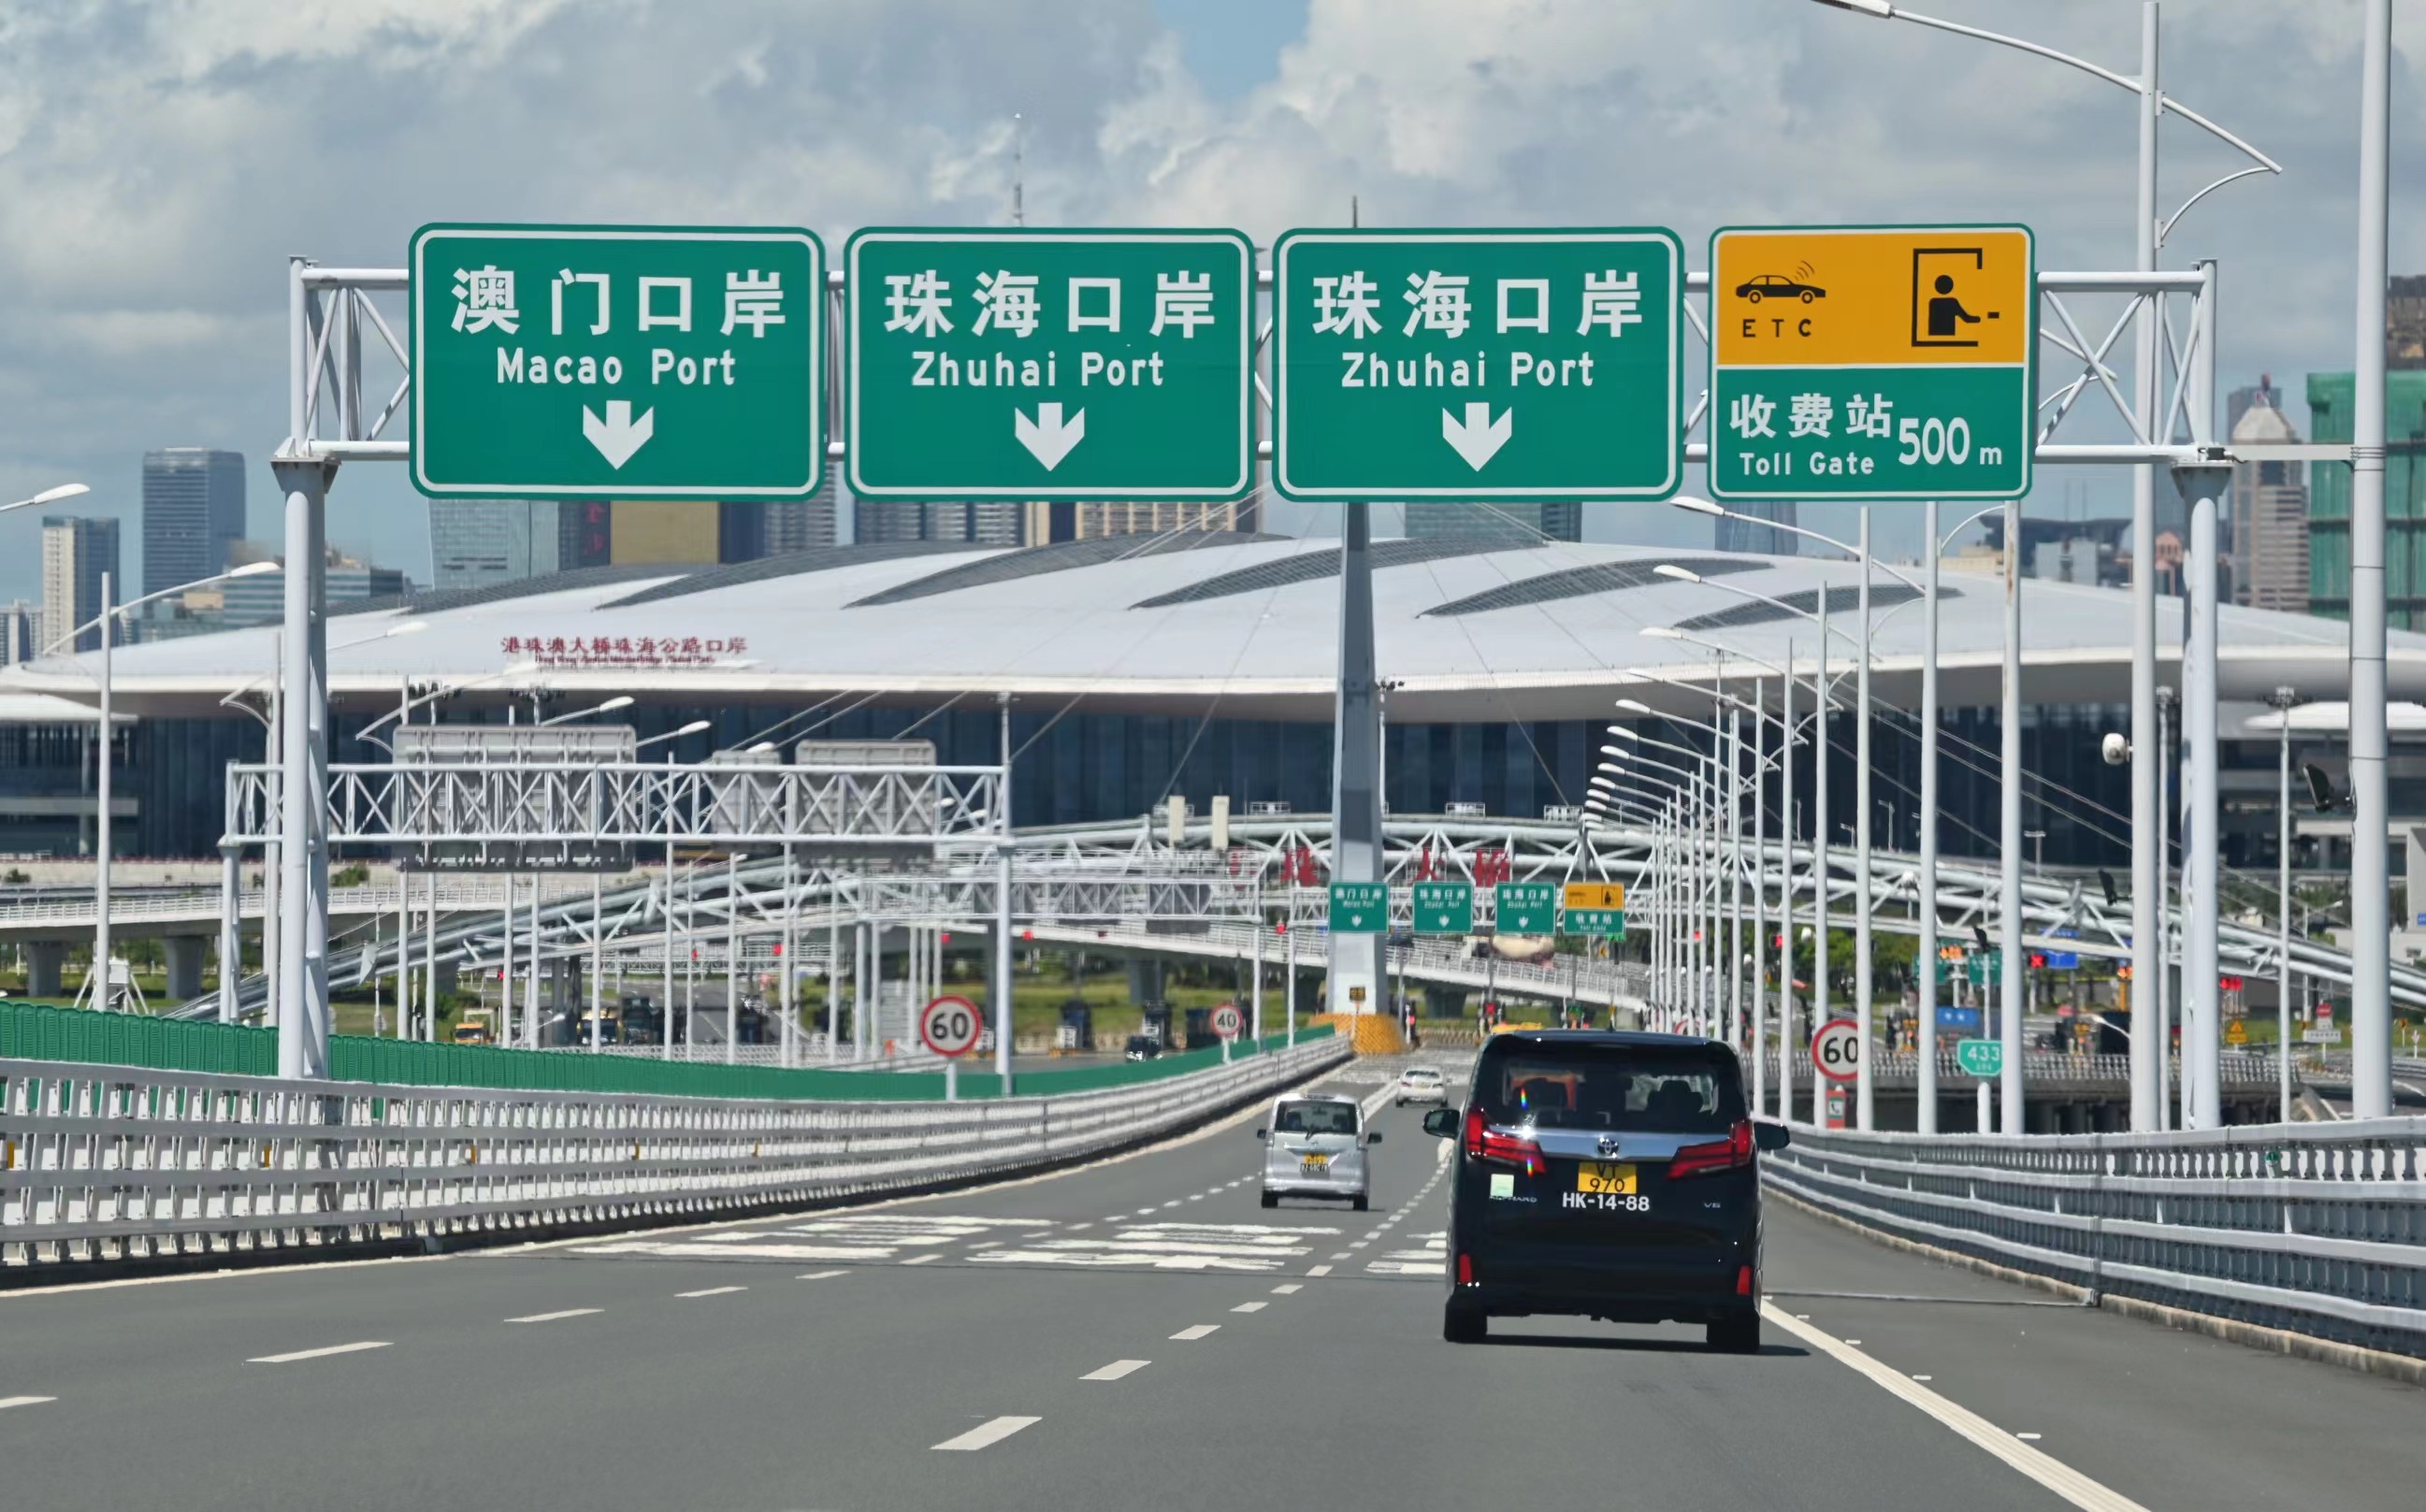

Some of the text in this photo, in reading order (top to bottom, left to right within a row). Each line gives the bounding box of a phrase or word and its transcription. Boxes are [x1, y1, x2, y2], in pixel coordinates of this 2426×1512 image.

[450, 266, 787, 338] 澳门口岸
[884, 268, 1215, 339] 珠海口岸
[1312, 268, 1642, 339] 珠海口岸
[1742, 318, 1812, 338] ETC
[497, 347, 736, 386] Macao Port
[912, 351, 1164, 387] Zhuhai Port
[1341, 351, 1595, 388] Zhuhai Port
[1729, 393, 1894, 439] 收费站
[1898, 416, 2002, 466] 500 m
[1739, 451, 1874, 476] Toll Gate
[931, 1013, 969, 1040] 60
[1217, 1013, 1237, 1028] 40
[1824, 1036, 1858, 1064] 60
[1589, 1178, 1625, 1192] 970
[1596, 1163, 1618, 1179] VT
[1562, 1191, 1650, 1212] HK-14-88
